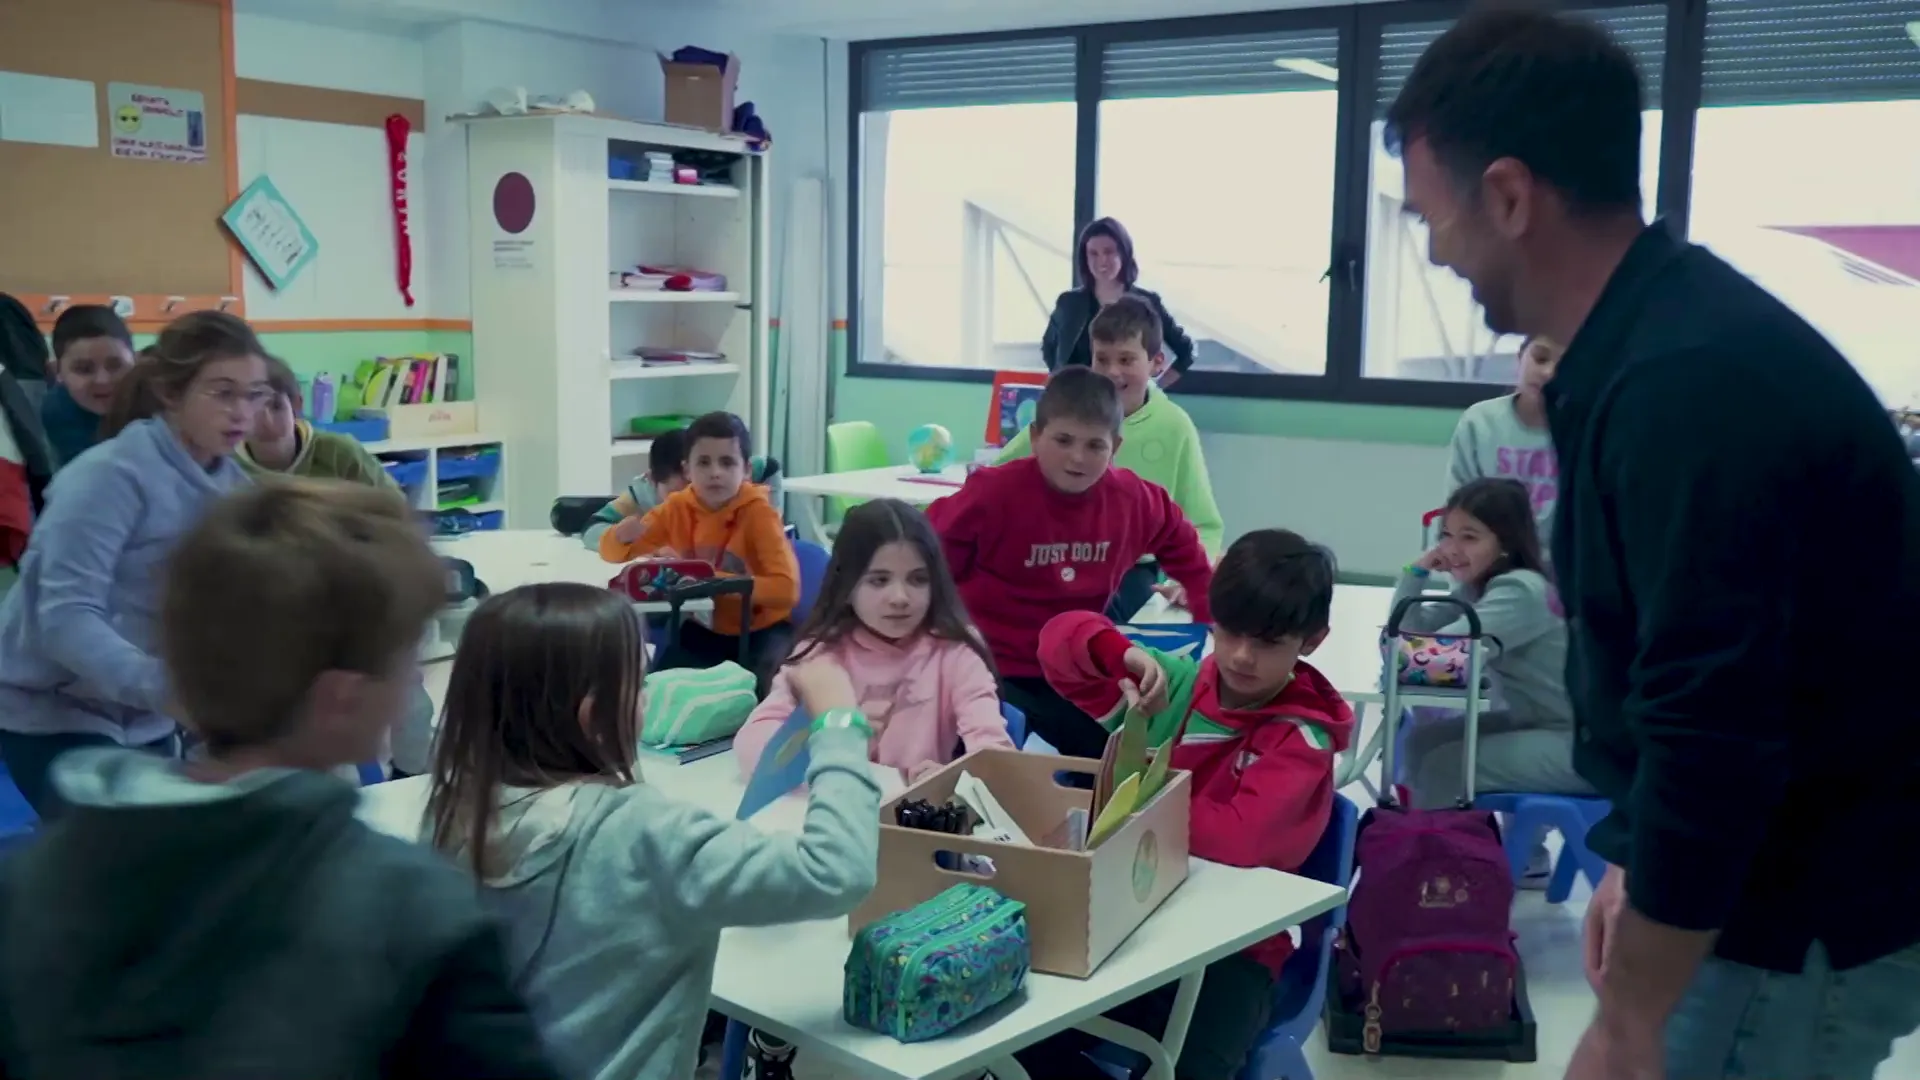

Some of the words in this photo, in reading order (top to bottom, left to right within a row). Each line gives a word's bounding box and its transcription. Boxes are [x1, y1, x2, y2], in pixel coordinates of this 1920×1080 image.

[1024, 543, 1069, 567] JUST
[1070, 542, 1092, 562] DO
[1093, 541, 1111, 562] IT
